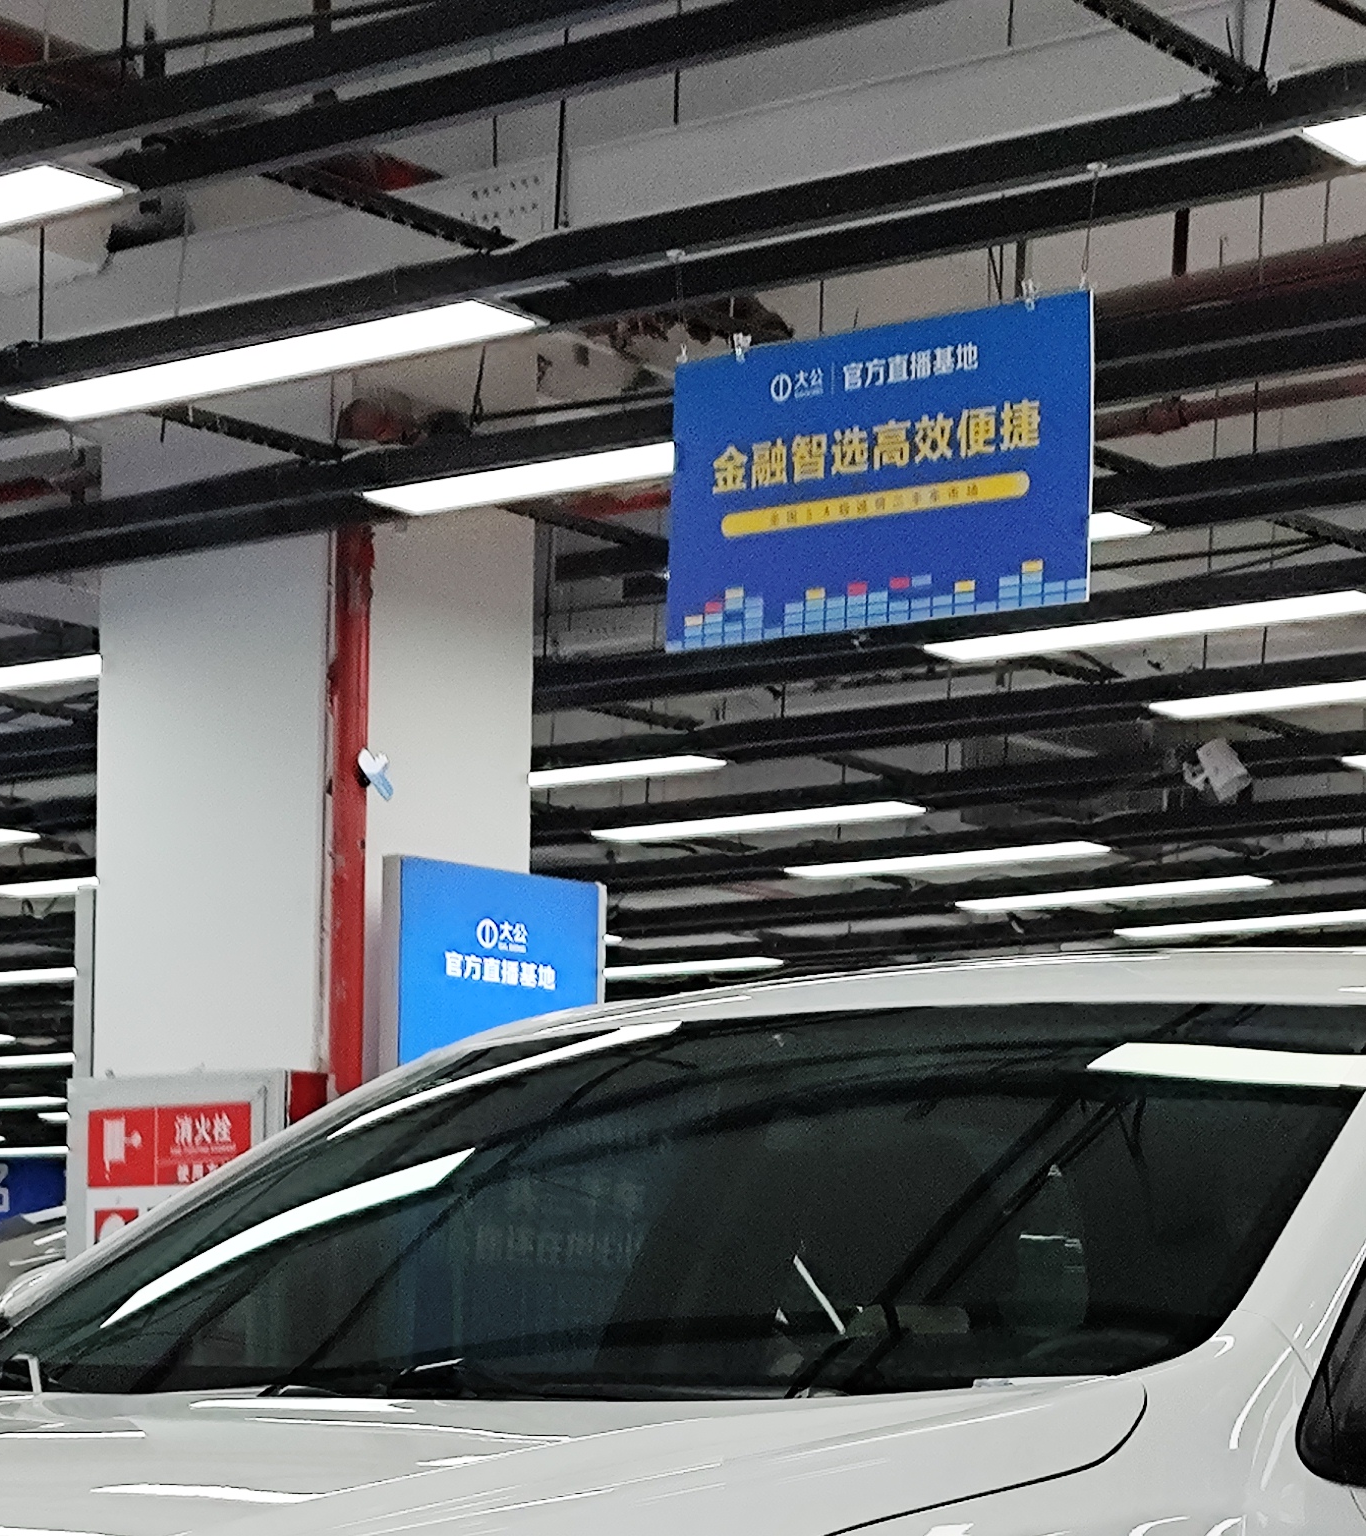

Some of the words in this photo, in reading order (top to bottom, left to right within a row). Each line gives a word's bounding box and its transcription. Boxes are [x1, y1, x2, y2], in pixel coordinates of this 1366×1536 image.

[794, 367, 824, 388] 大公
[843, 341, 979, 392] 官方直播基地
[712, 398, 1042, 494] 金融智选高效便捷
[500, 921, 528, 944] 大公
[444, 950, 556, 991] 官方直播基地
